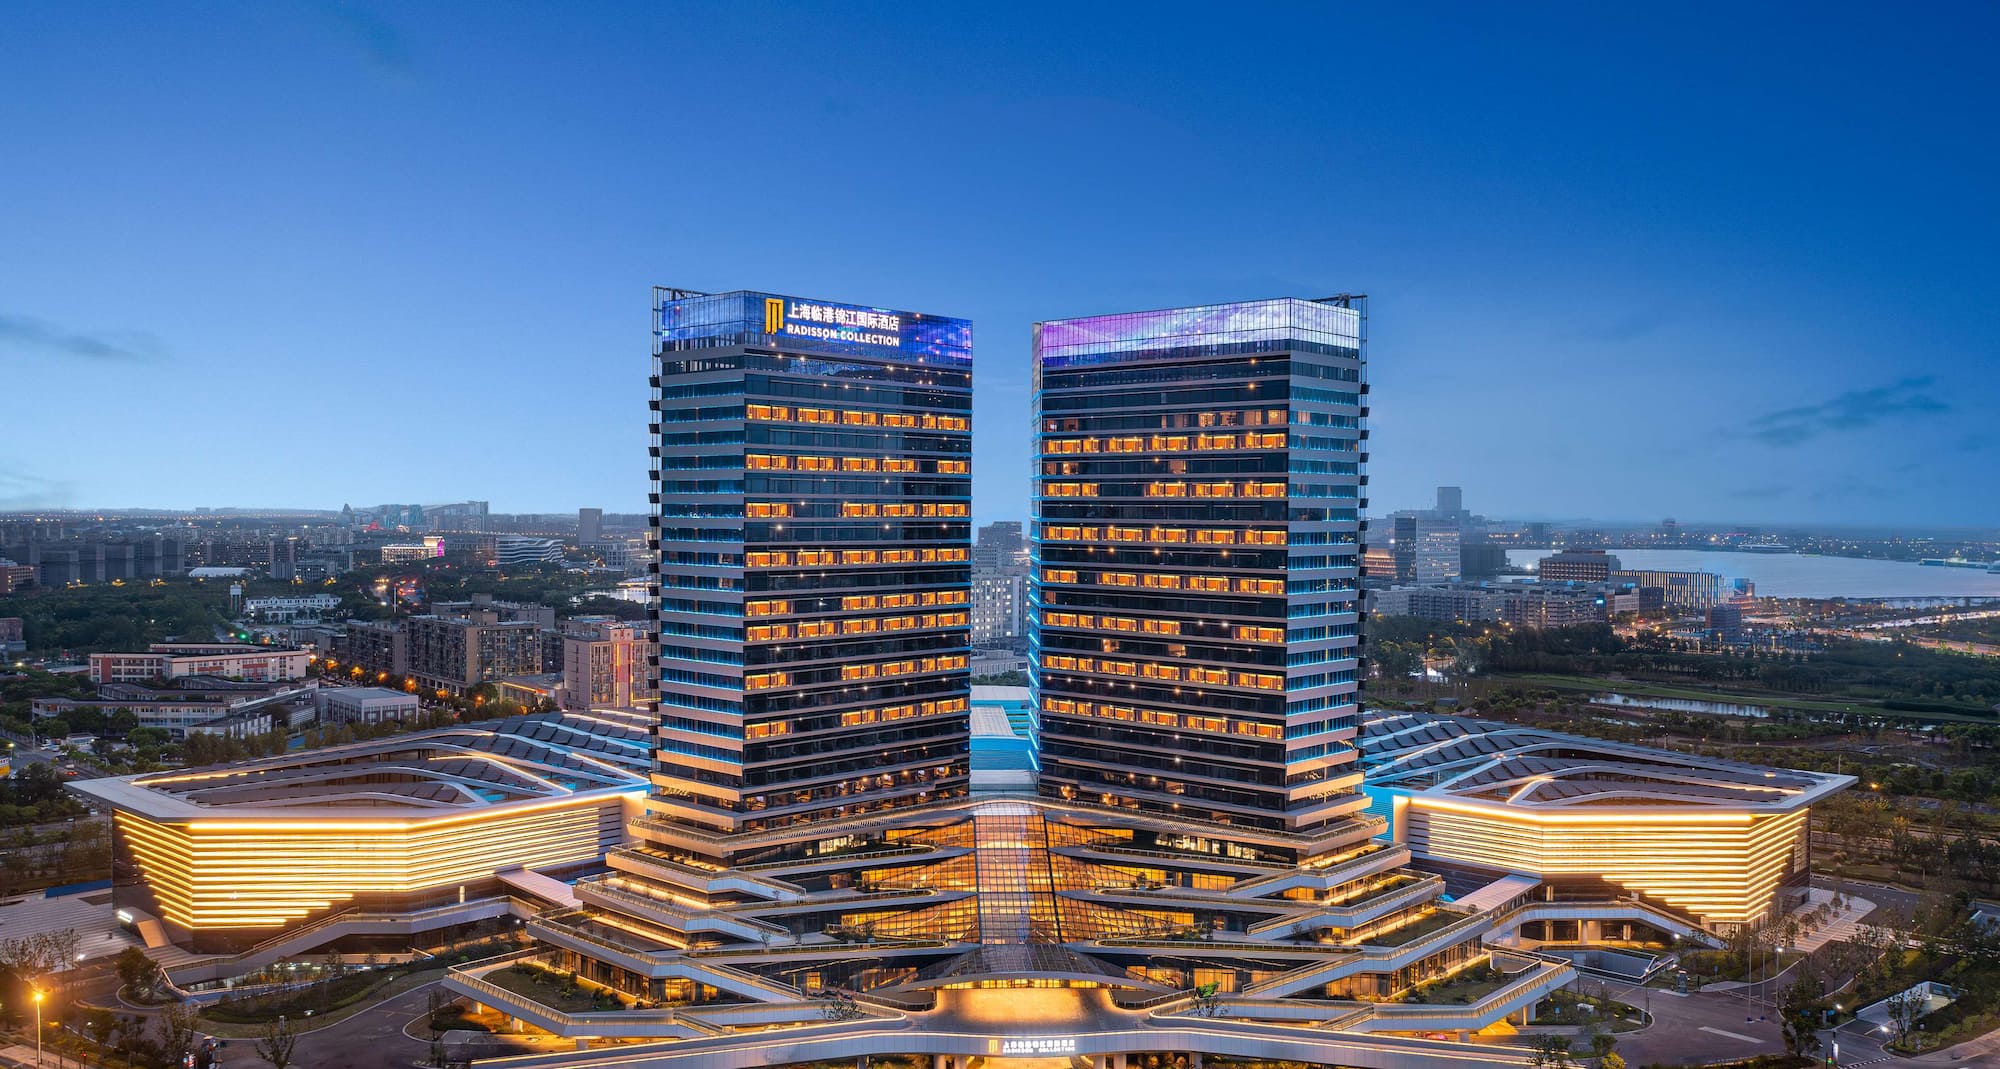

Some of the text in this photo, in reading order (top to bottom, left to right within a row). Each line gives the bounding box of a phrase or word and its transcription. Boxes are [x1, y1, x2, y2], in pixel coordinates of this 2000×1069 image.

[787, 302, 900, 332] 上海临港锦江国际酒店
[786, 323, 900, 347] RADISSON COLLECTION
